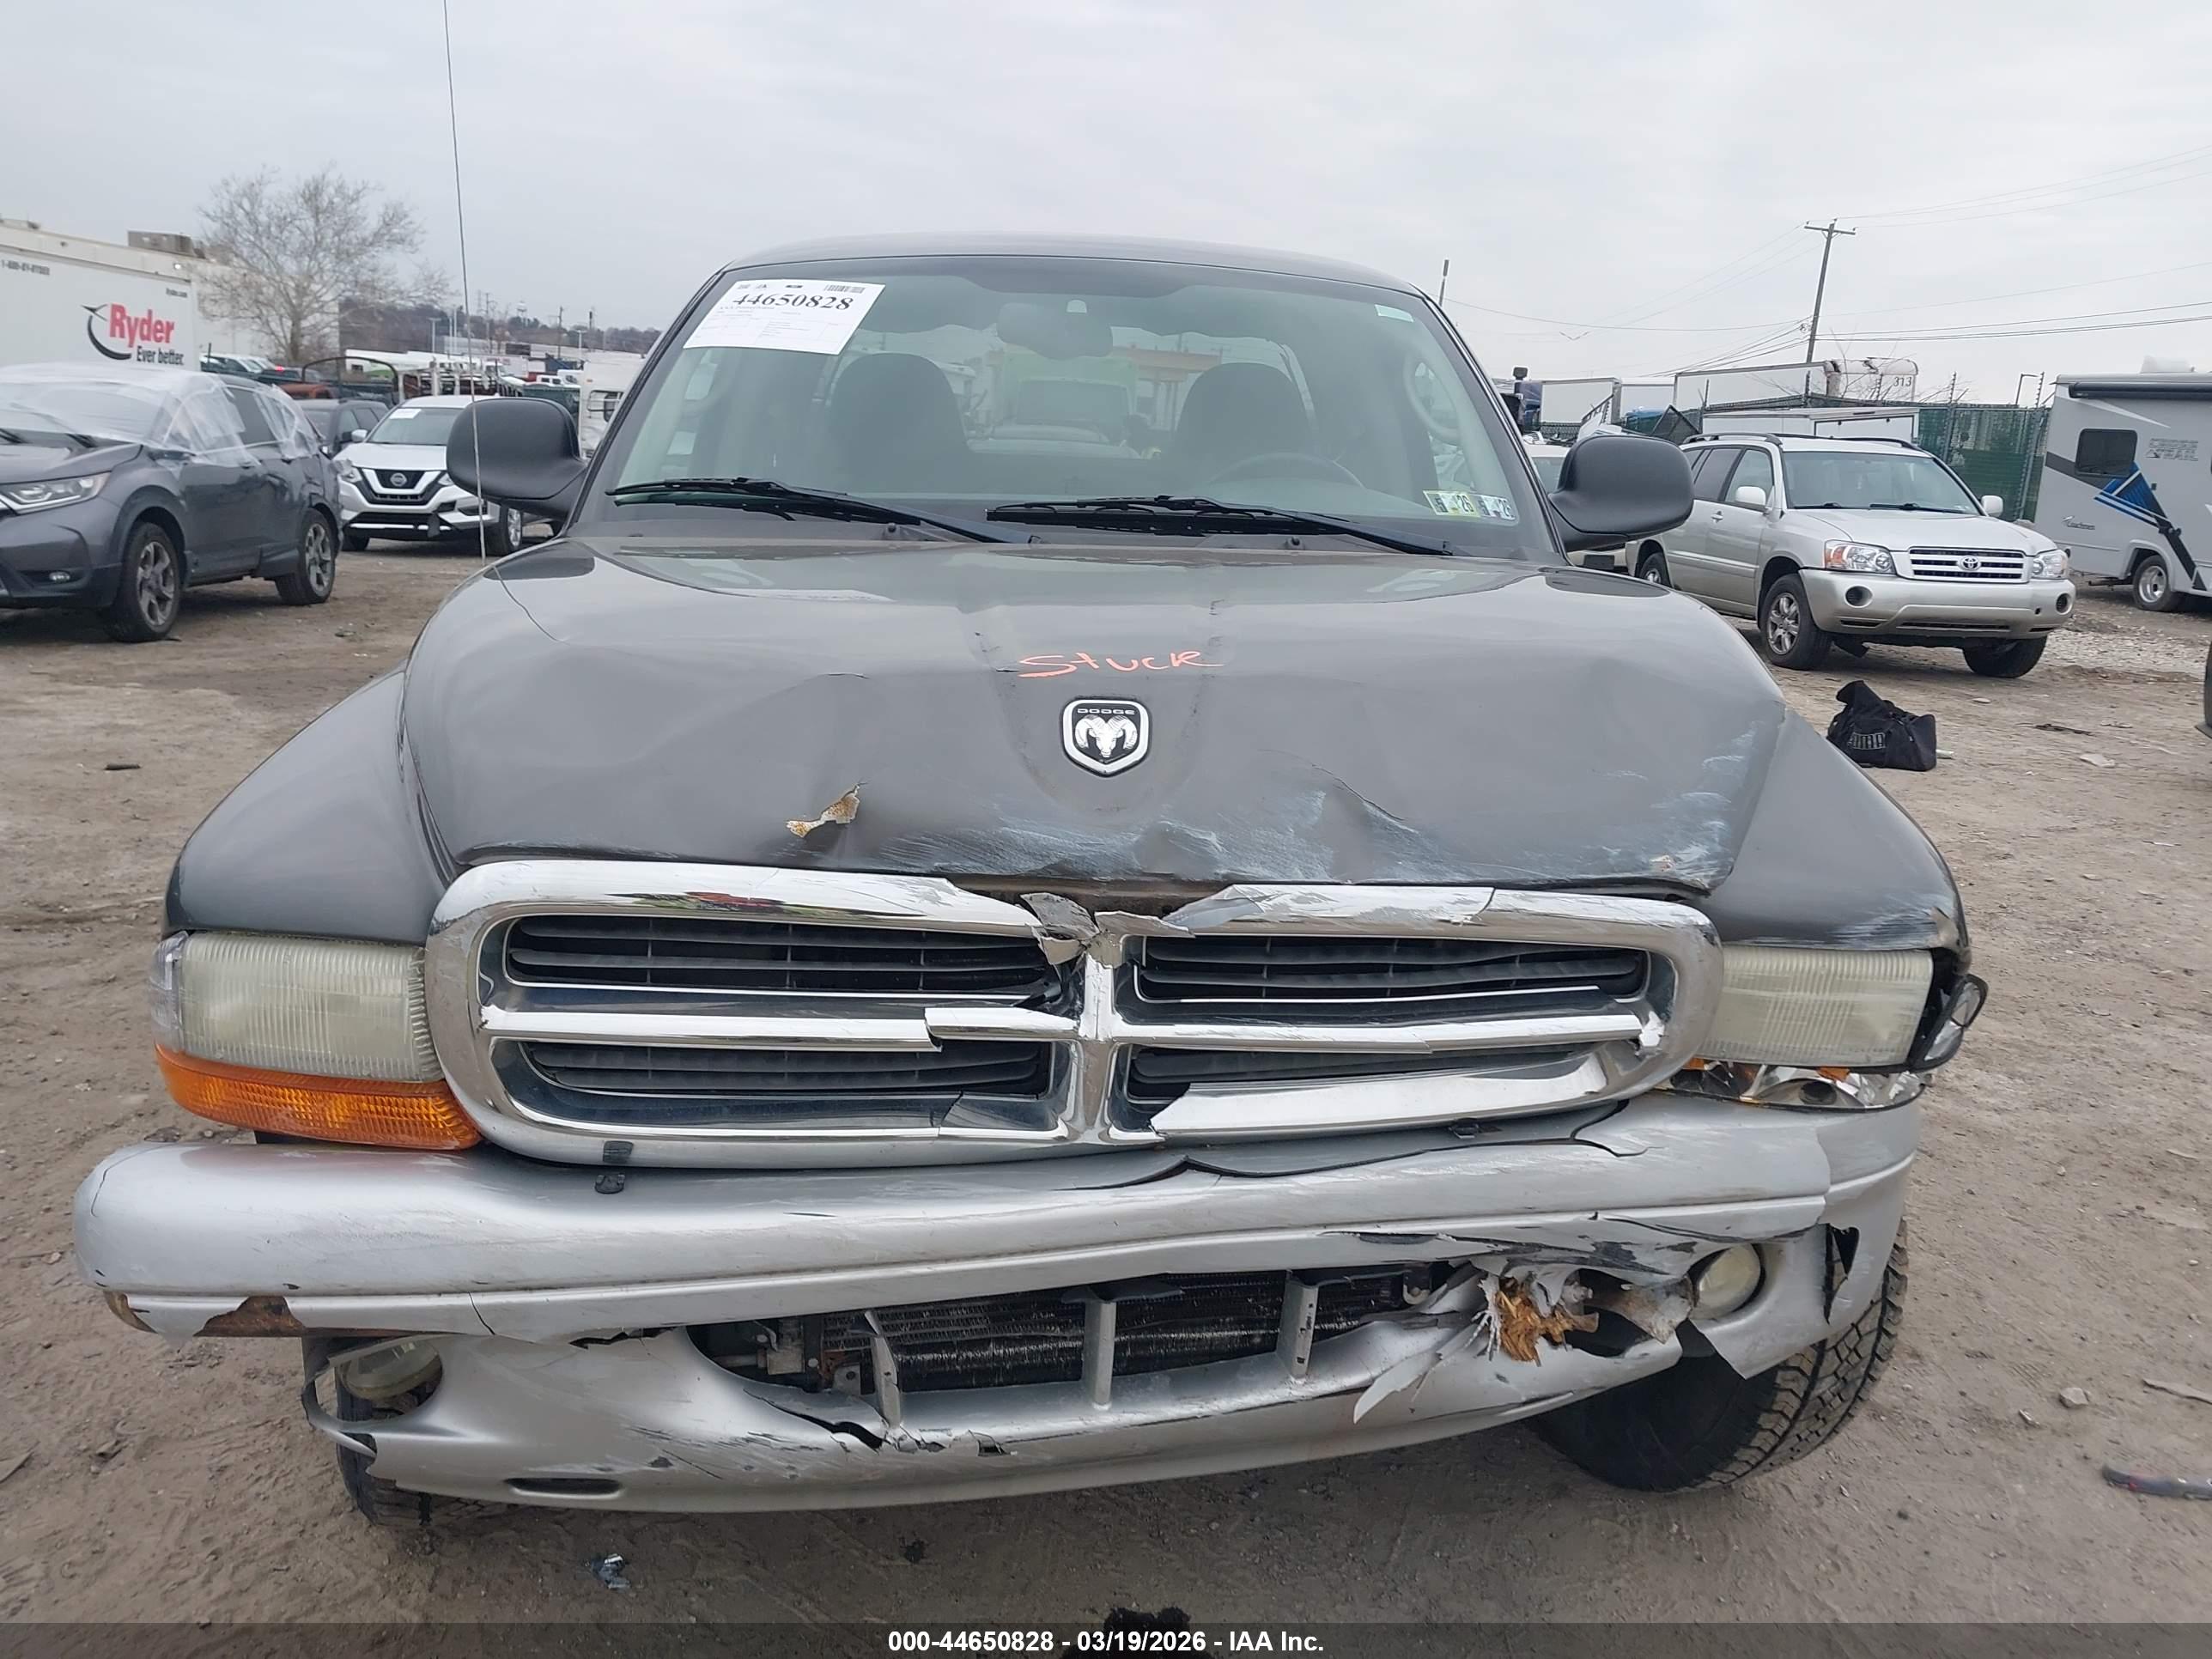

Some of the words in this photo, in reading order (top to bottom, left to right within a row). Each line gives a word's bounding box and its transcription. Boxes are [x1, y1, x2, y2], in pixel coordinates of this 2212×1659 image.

[732, 293, 854, 311] 44650828
[109, 303, 175, 348] Ryder
[137, 345, 155, 363] Ever
